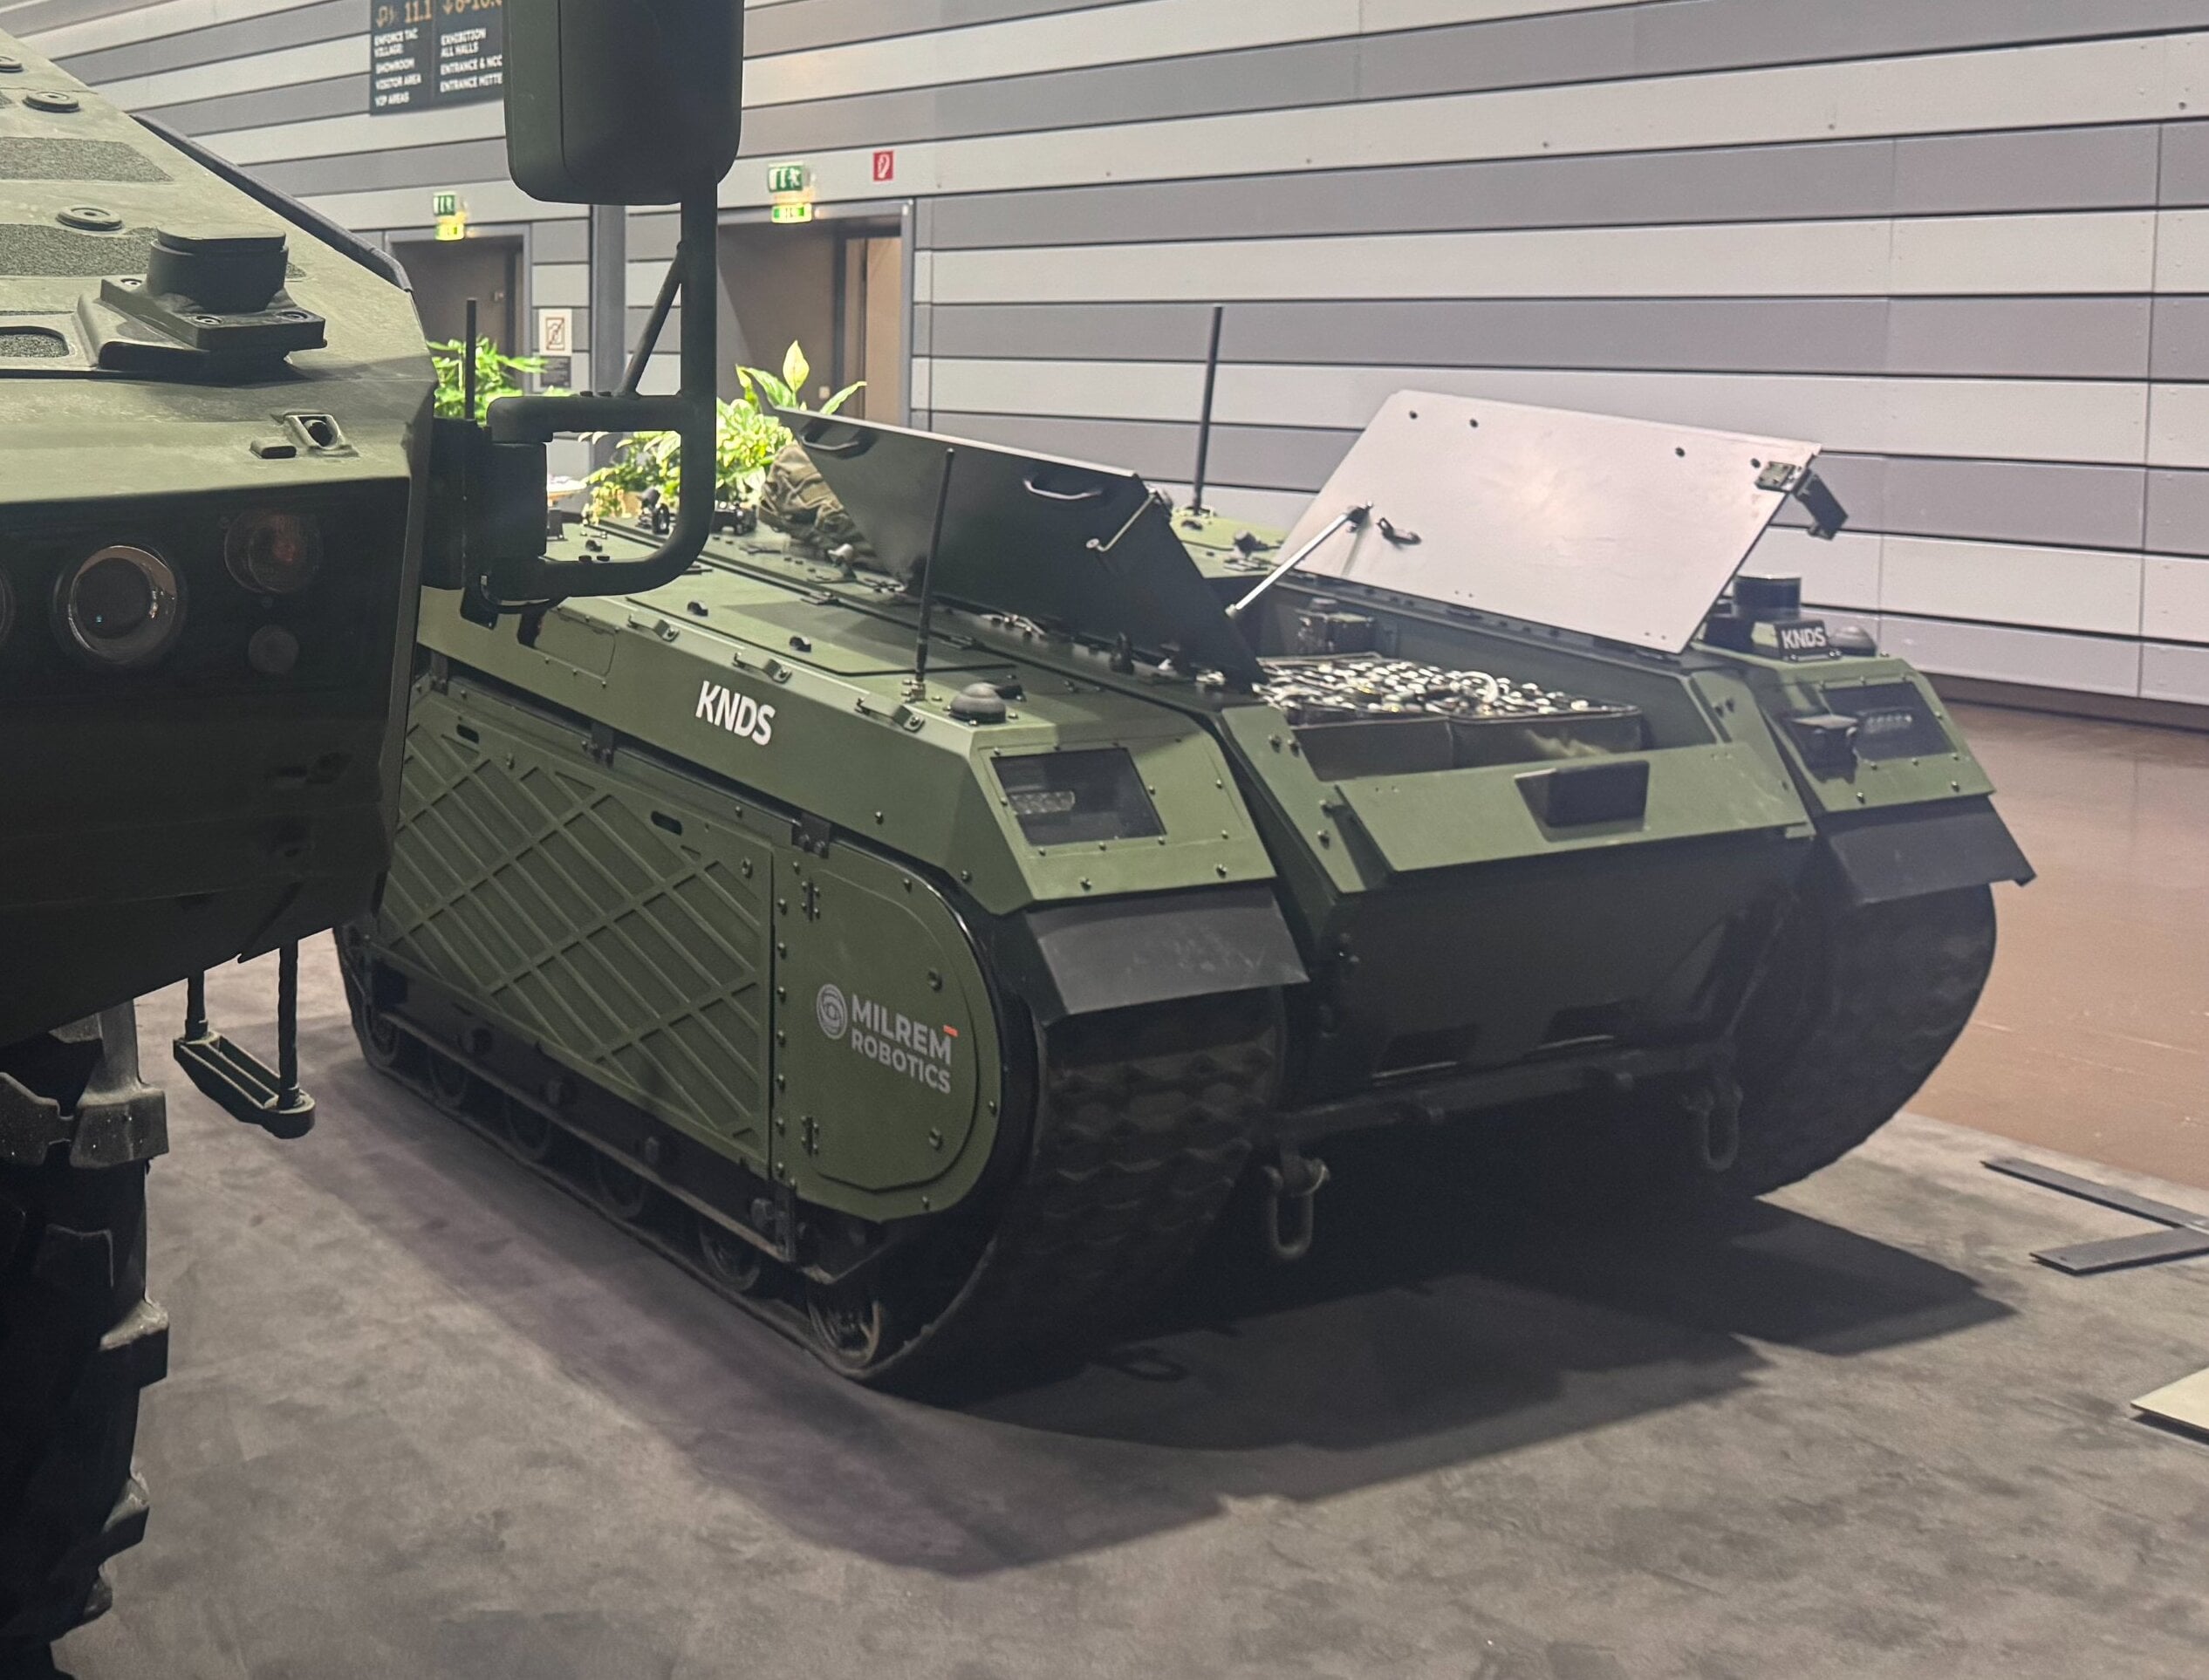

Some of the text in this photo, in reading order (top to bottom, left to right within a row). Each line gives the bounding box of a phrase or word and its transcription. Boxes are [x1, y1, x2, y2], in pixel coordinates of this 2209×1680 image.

[405, 0, 432, 24] 11.1
[441, 28, 486, 46] EXHIBITION
[441, 58, 478, 76] ENTRANCE
[440, 76, 478, 92] ENTRANCE
[1782, 627, 1827, 649] KNDS
[695, 680, 776, 746] KNDS
[851, 994, 953, 1066] MILREM
[851, 1028, 951, 1094] ROBOTICS
